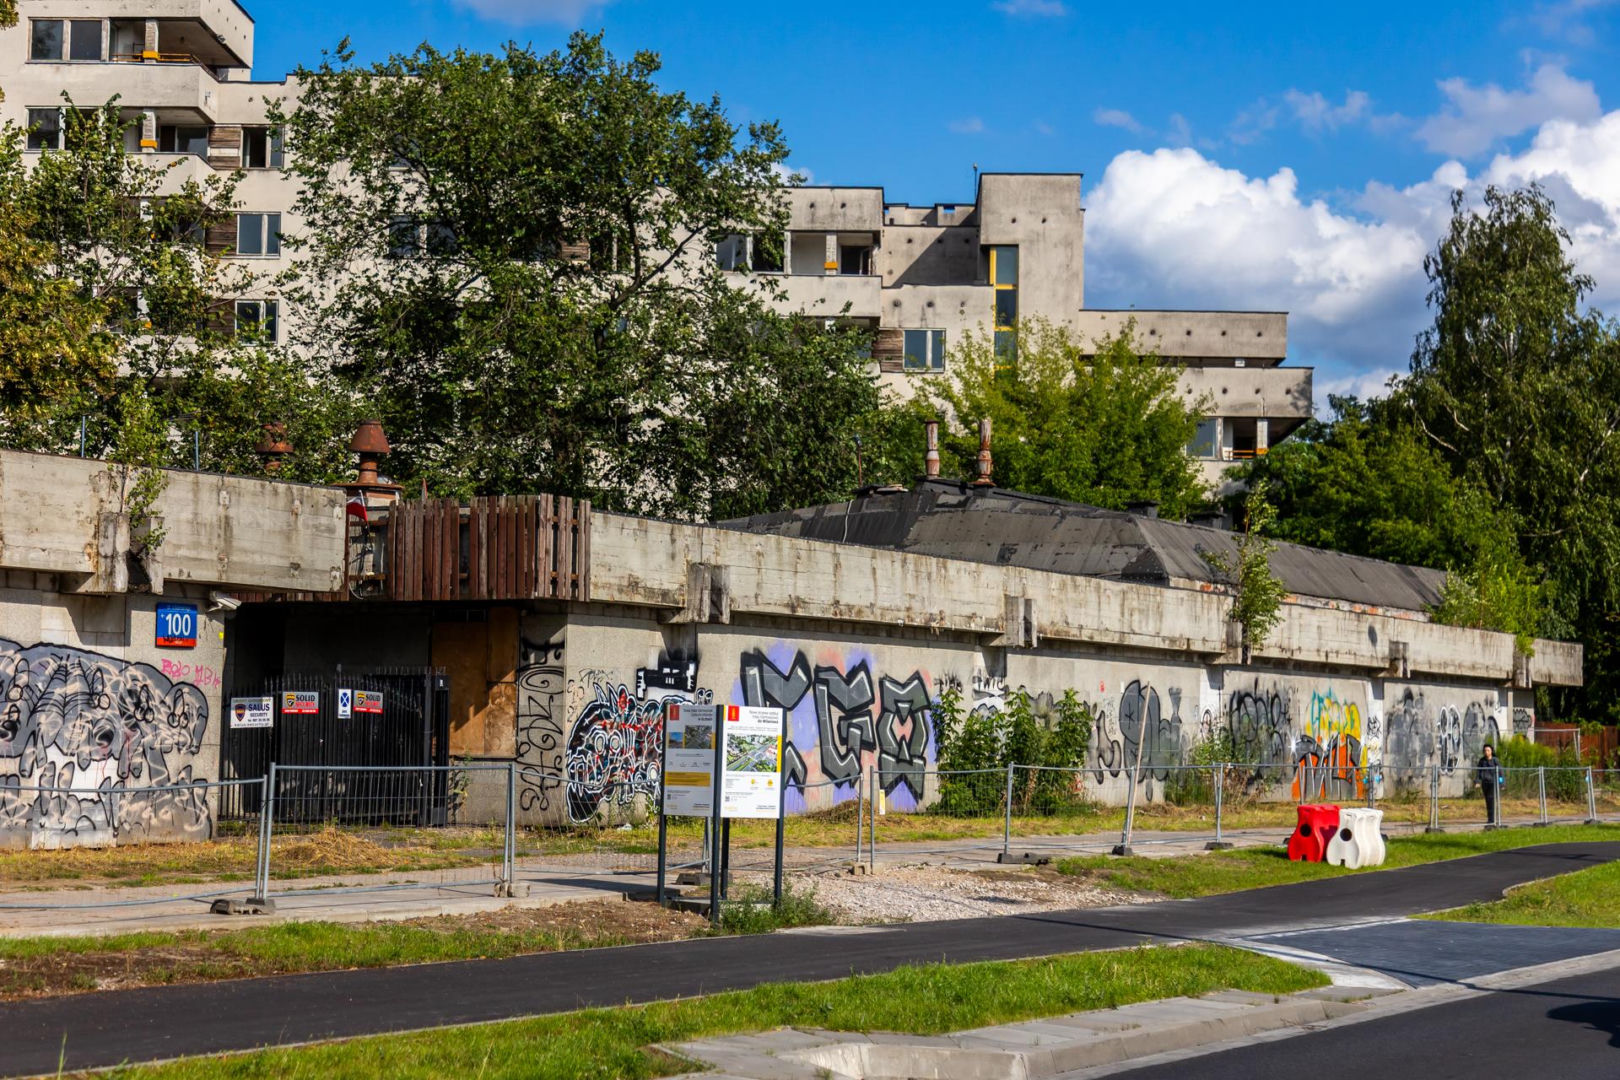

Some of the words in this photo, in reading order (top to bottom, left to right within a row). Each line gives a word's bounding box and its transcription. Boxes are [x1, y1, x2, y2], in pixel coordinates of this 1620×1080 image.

[165, 613, 191, 636] 100
[295, 694, 316, 702] SOLID
[365, 693, 381, 702] SOLID
[248, 703, 270, 712] SALUS
